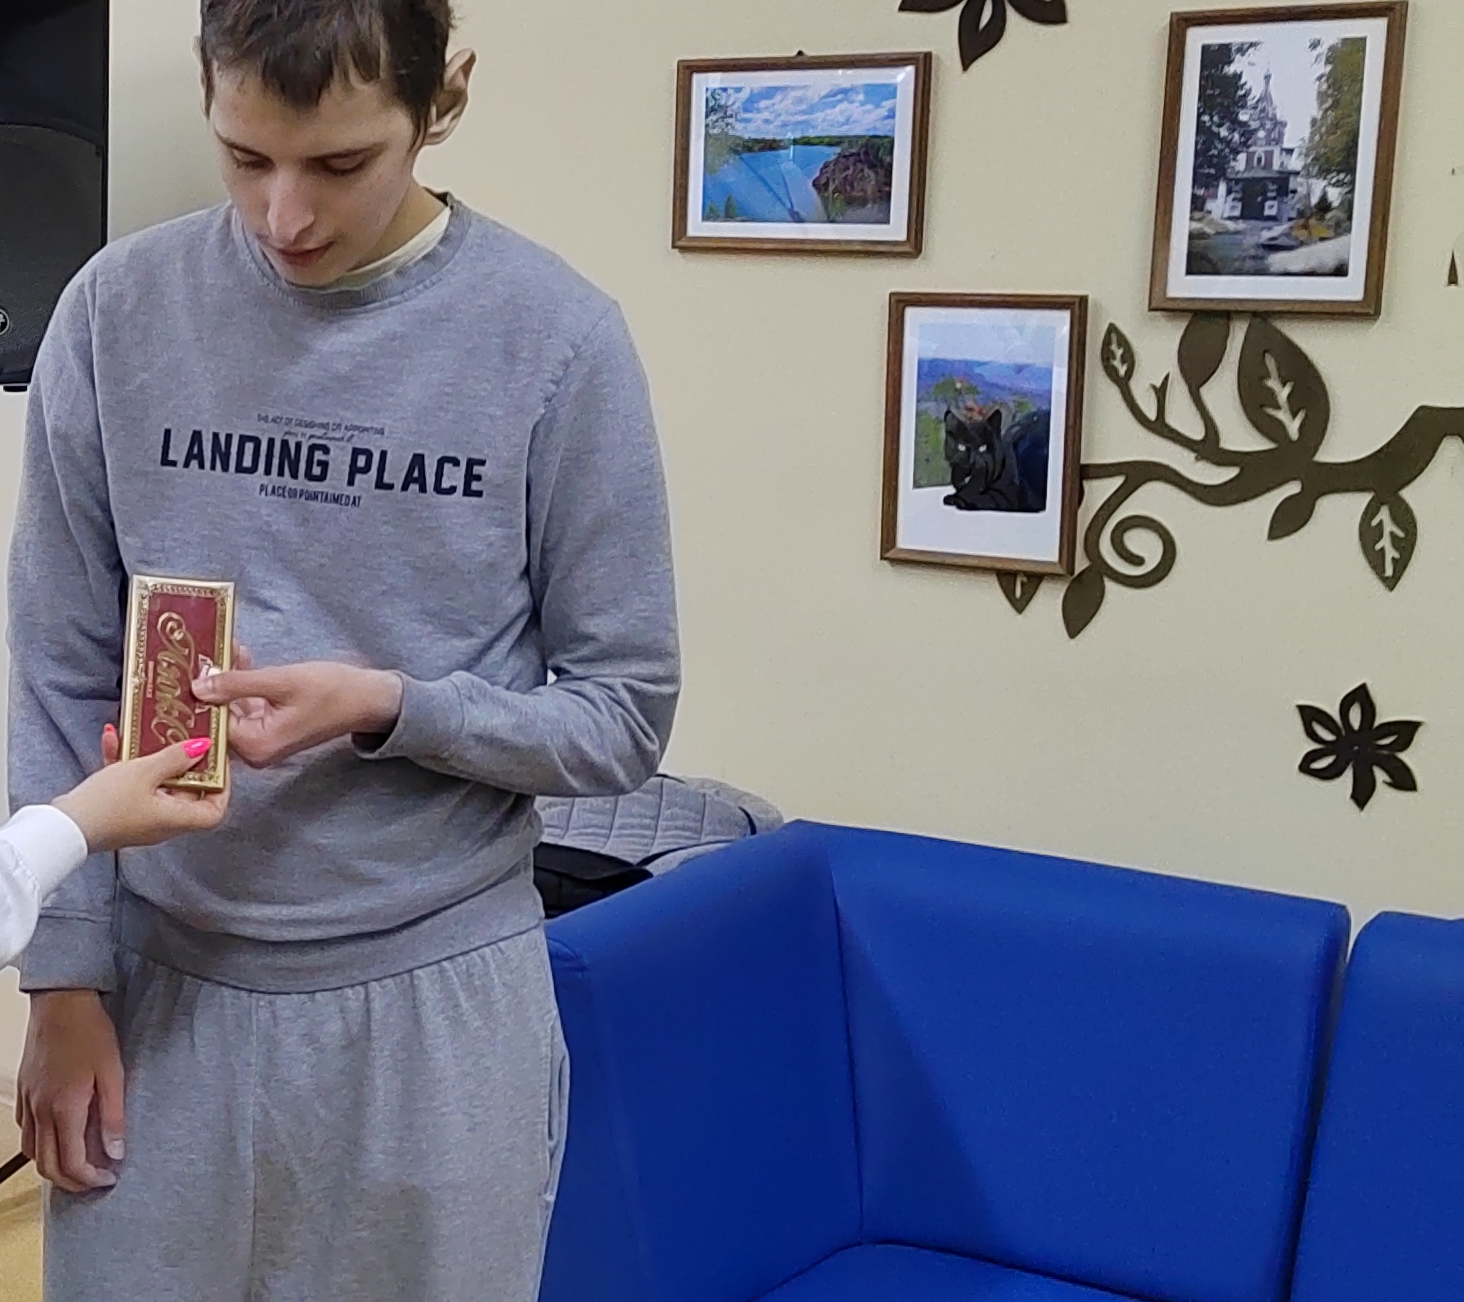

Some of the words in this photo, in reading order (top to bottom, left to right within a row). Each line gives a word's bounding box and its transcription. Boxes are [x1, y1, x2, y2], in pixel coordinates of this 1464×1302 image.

[160, 428, 331, 483] LANDING
[346, 446, 487, 498] PLACE
[259, 483, 286, 499] PLACE
